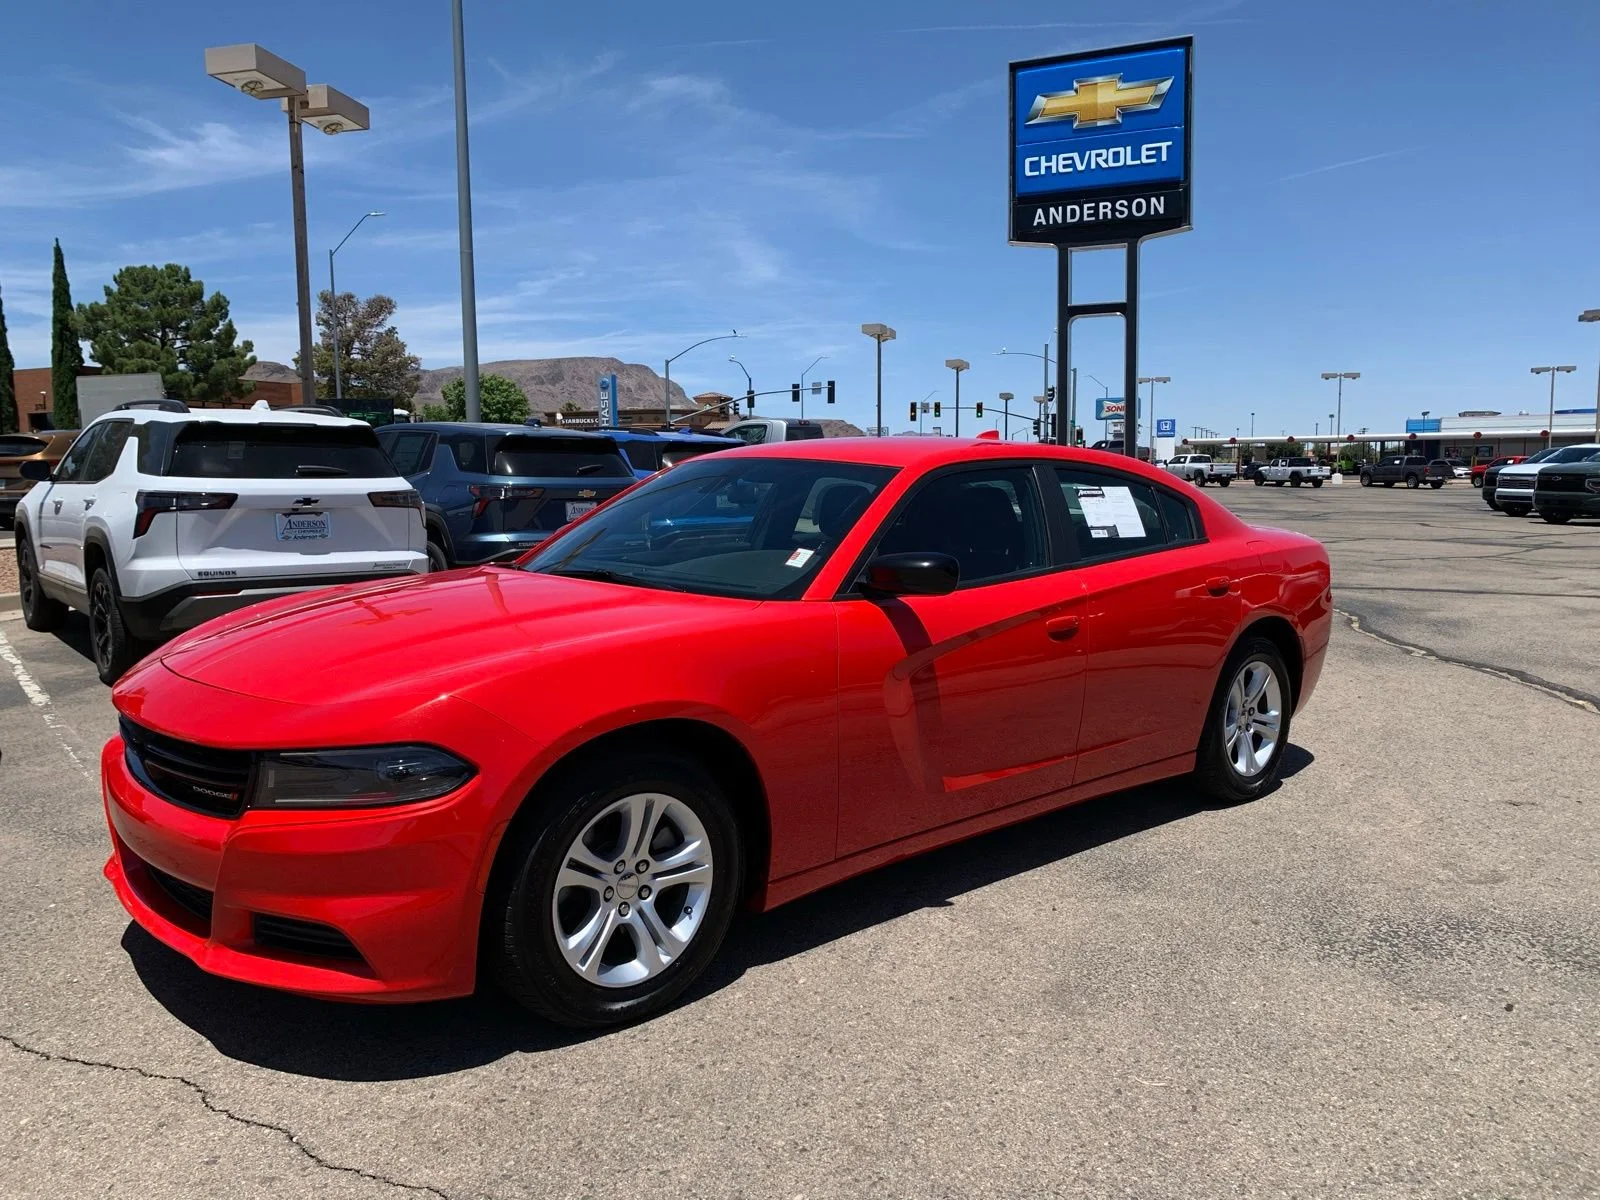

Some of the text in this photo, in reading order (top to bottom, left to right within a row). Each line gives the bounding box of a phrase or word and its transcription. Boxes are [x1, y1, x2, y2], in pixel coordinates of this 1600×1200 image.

[1024, 141, 1172, 176] CHEVROLET
[1033, 196, 1165, 226] ANDERSON
[600, 391, 609, 426] HASE
[1105, 405, 1127, 413] SONI
[281, 519, 326, 535] ANDERSON
[193, 785, 232, 800] DODGE
